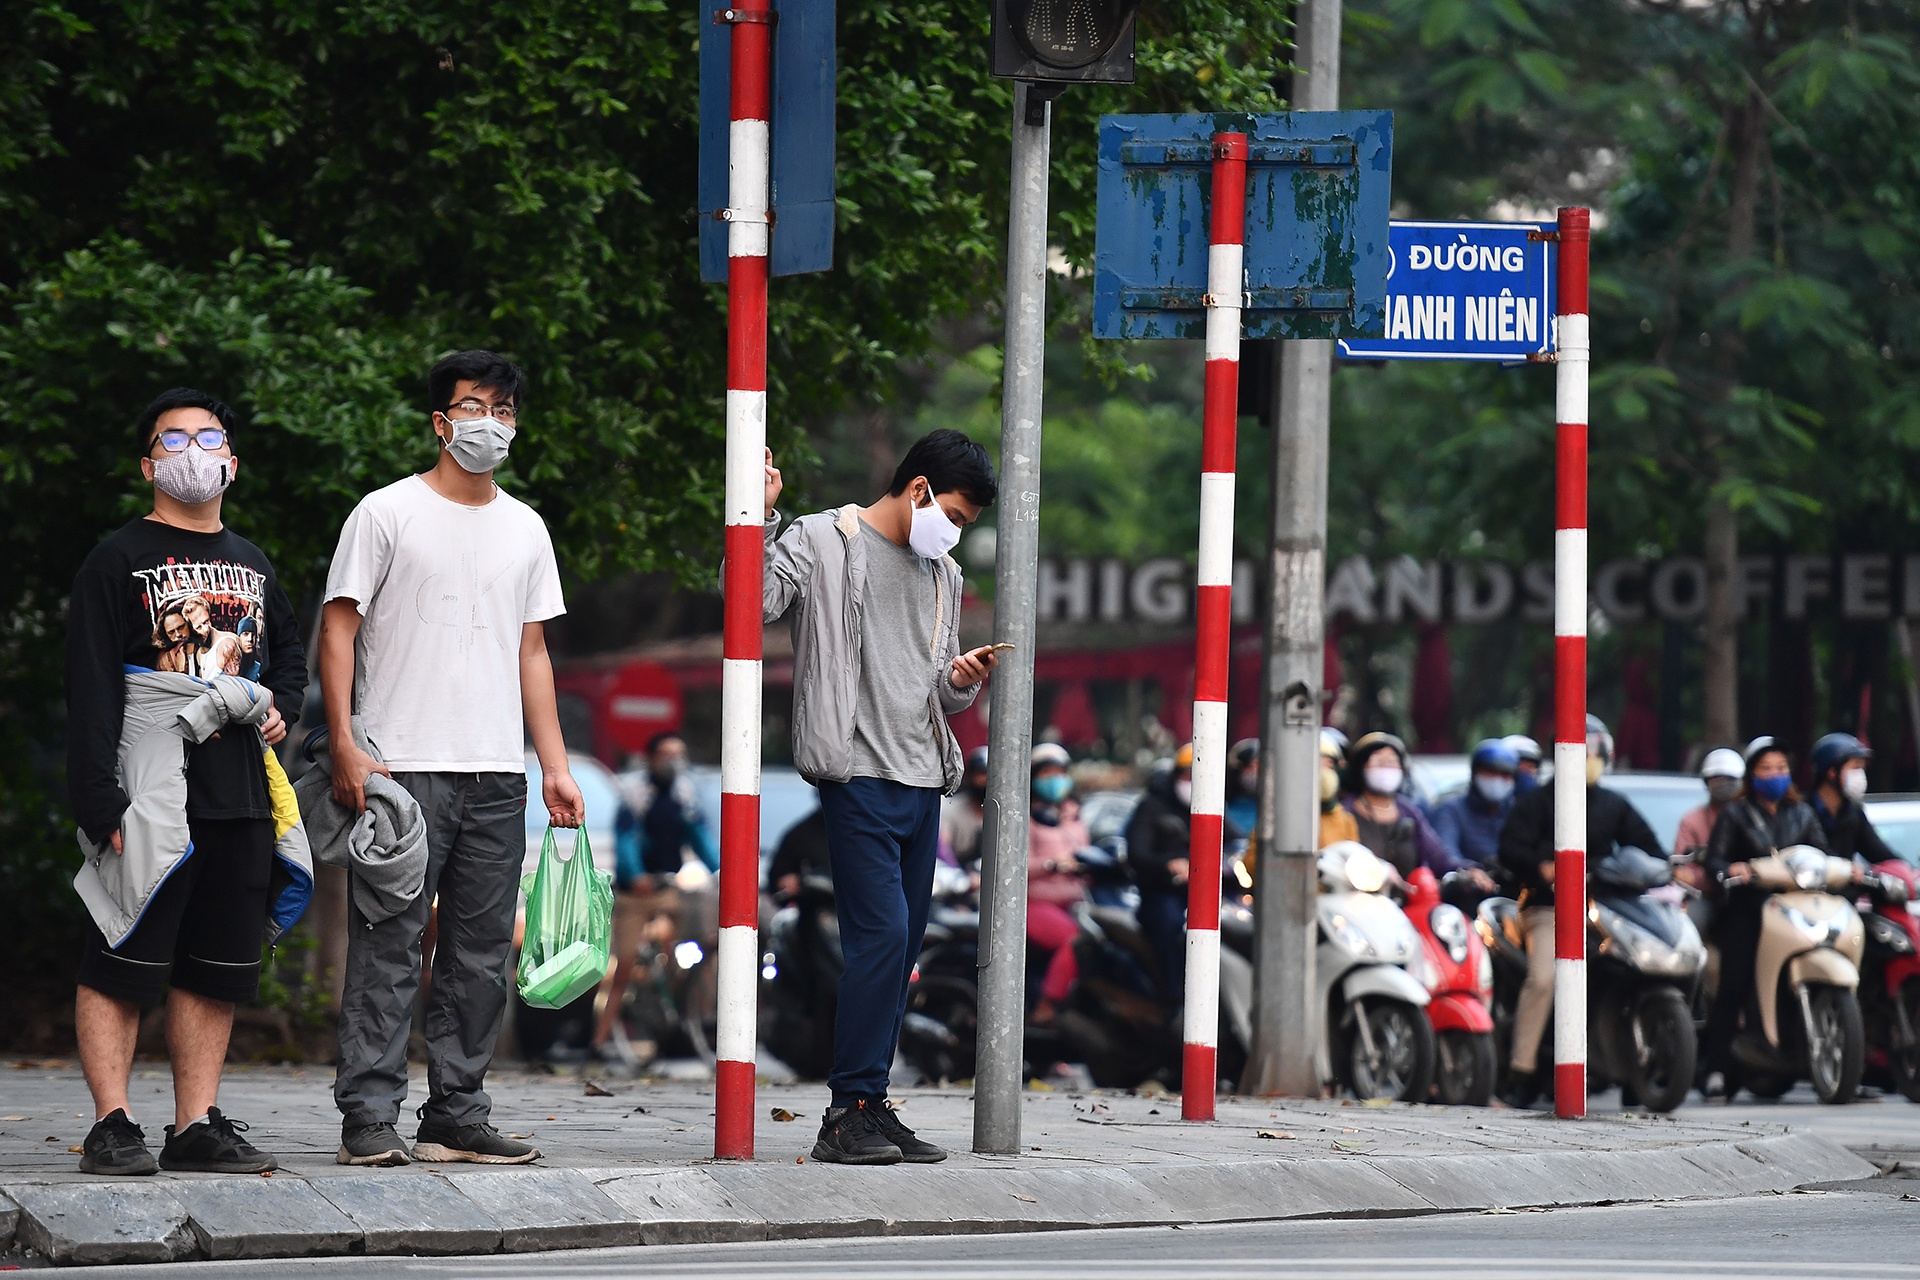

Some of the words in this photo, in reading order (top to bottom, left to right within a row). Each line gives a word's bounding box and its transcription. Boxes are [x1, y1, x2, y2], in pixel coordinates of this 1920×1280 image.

[1408, 233, 1524, 273] ĐƯỜNG
[1384, 294, 1456, 341] ANH
[1464, 287, 1538, 343] NIÊN
[1037, 554, 1557, 624] HIGANDS
